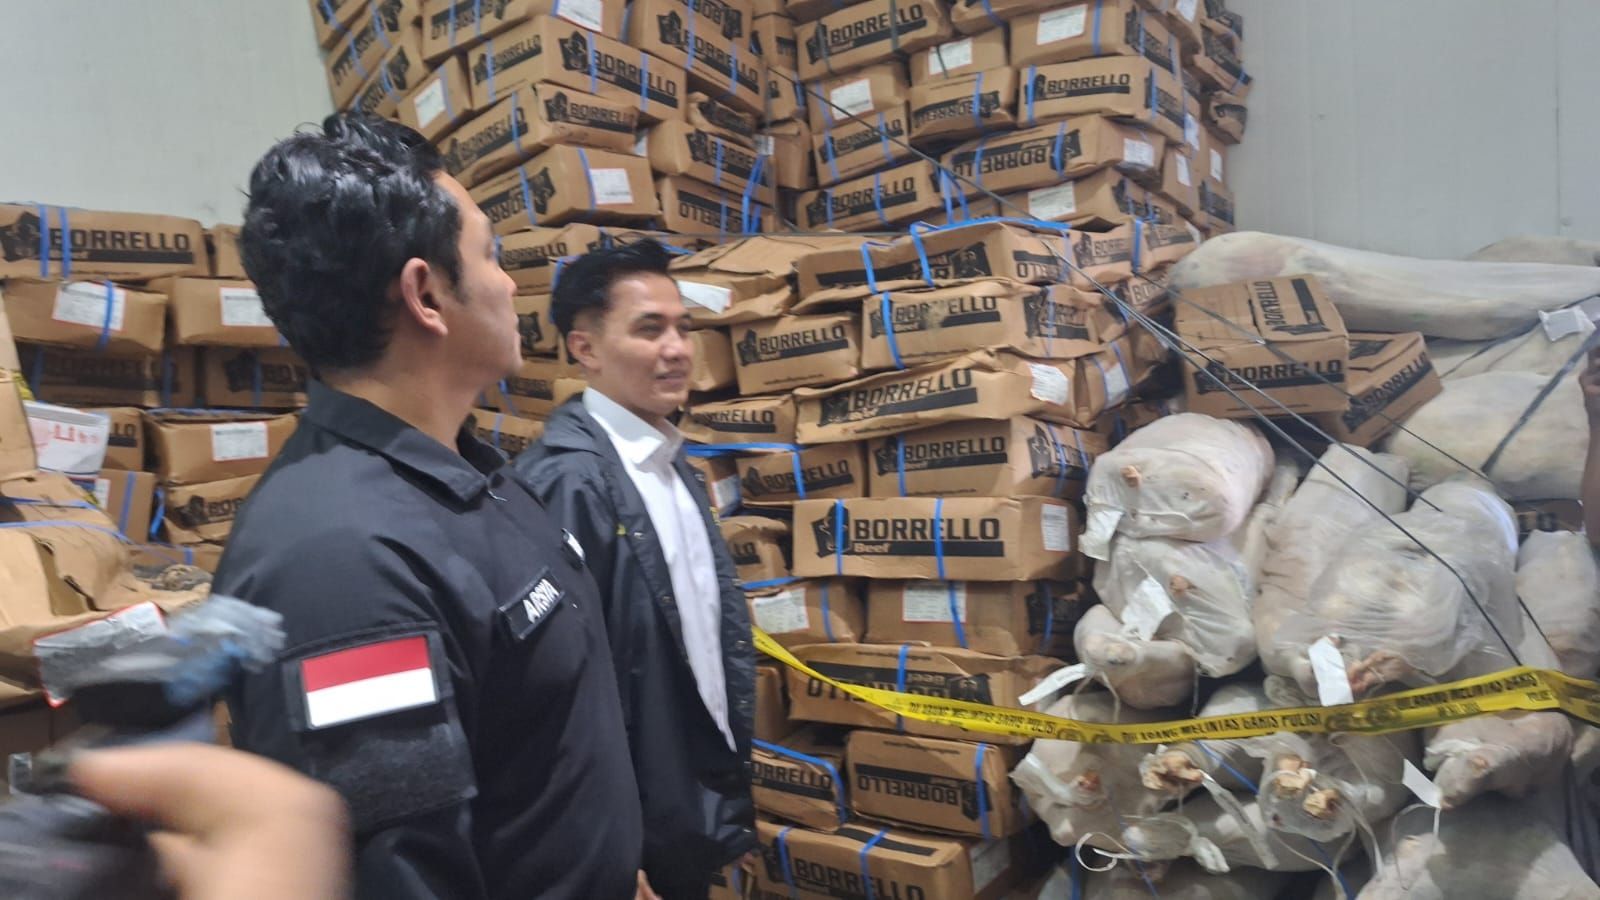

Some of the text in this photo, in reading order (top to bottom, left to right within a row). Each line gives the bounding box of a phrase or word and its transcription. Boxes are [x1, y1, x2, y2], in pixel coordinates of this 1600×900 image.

[831, 4, 924, 44] BORRELO
[895, 295, 997, 322] BORELLO
[759, 325, 846, 352] BORRELLO
[853, 367, 973, 411] BORRELLO
[903, 435, 1006, 460] BORRELLO
[854, 542, 890, 554] Beef
[752, 763, 832, 789] ORRELLO
[857, 774, 960, 806] BORRELLO
